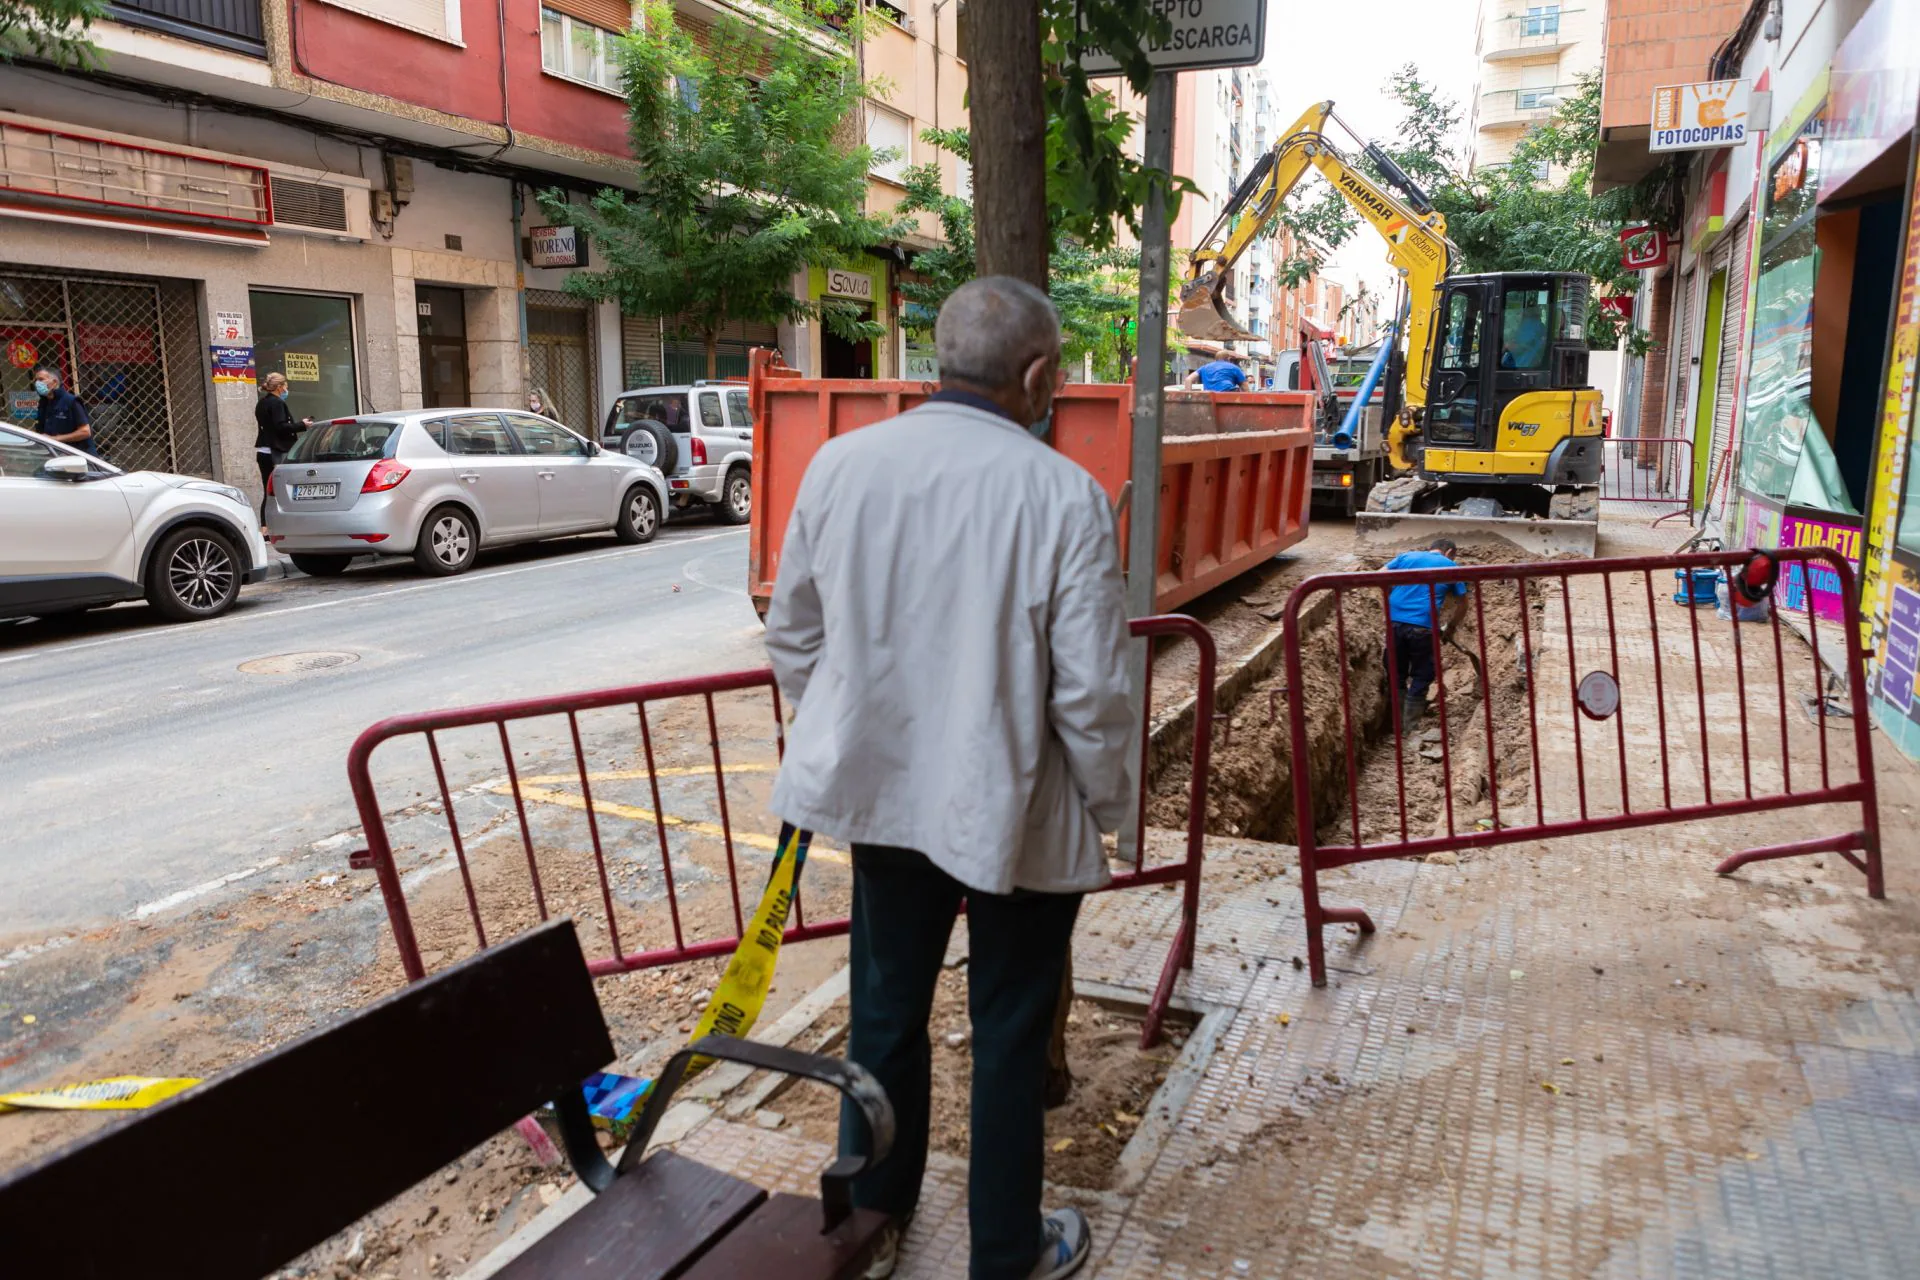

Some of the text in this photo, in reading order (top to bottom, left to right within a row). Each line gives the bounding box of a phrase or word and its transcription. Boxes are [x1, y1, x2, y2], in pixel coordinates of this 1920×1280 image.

[1152, 0, 1203, 19] EPTO
[1657, 90, 1672, 128] SIGNOS
[1657, 124, 1744, 146] FOTOCOPIAS
[1339, 172, 1393, 220] YANMAR
[534, 238, 575, 254] MORENO
[1409, 233, 1438, 261] asbeca
[545, 255, 576, 264] GOLOSINAS
[420, 304, 429, 313] 17
[287, 361, 317, 369] BELVA
[298, 485, 317, 496] 2787
[1787, 583, 1804, 611] DE
[755, 929, 779, 955] NO
